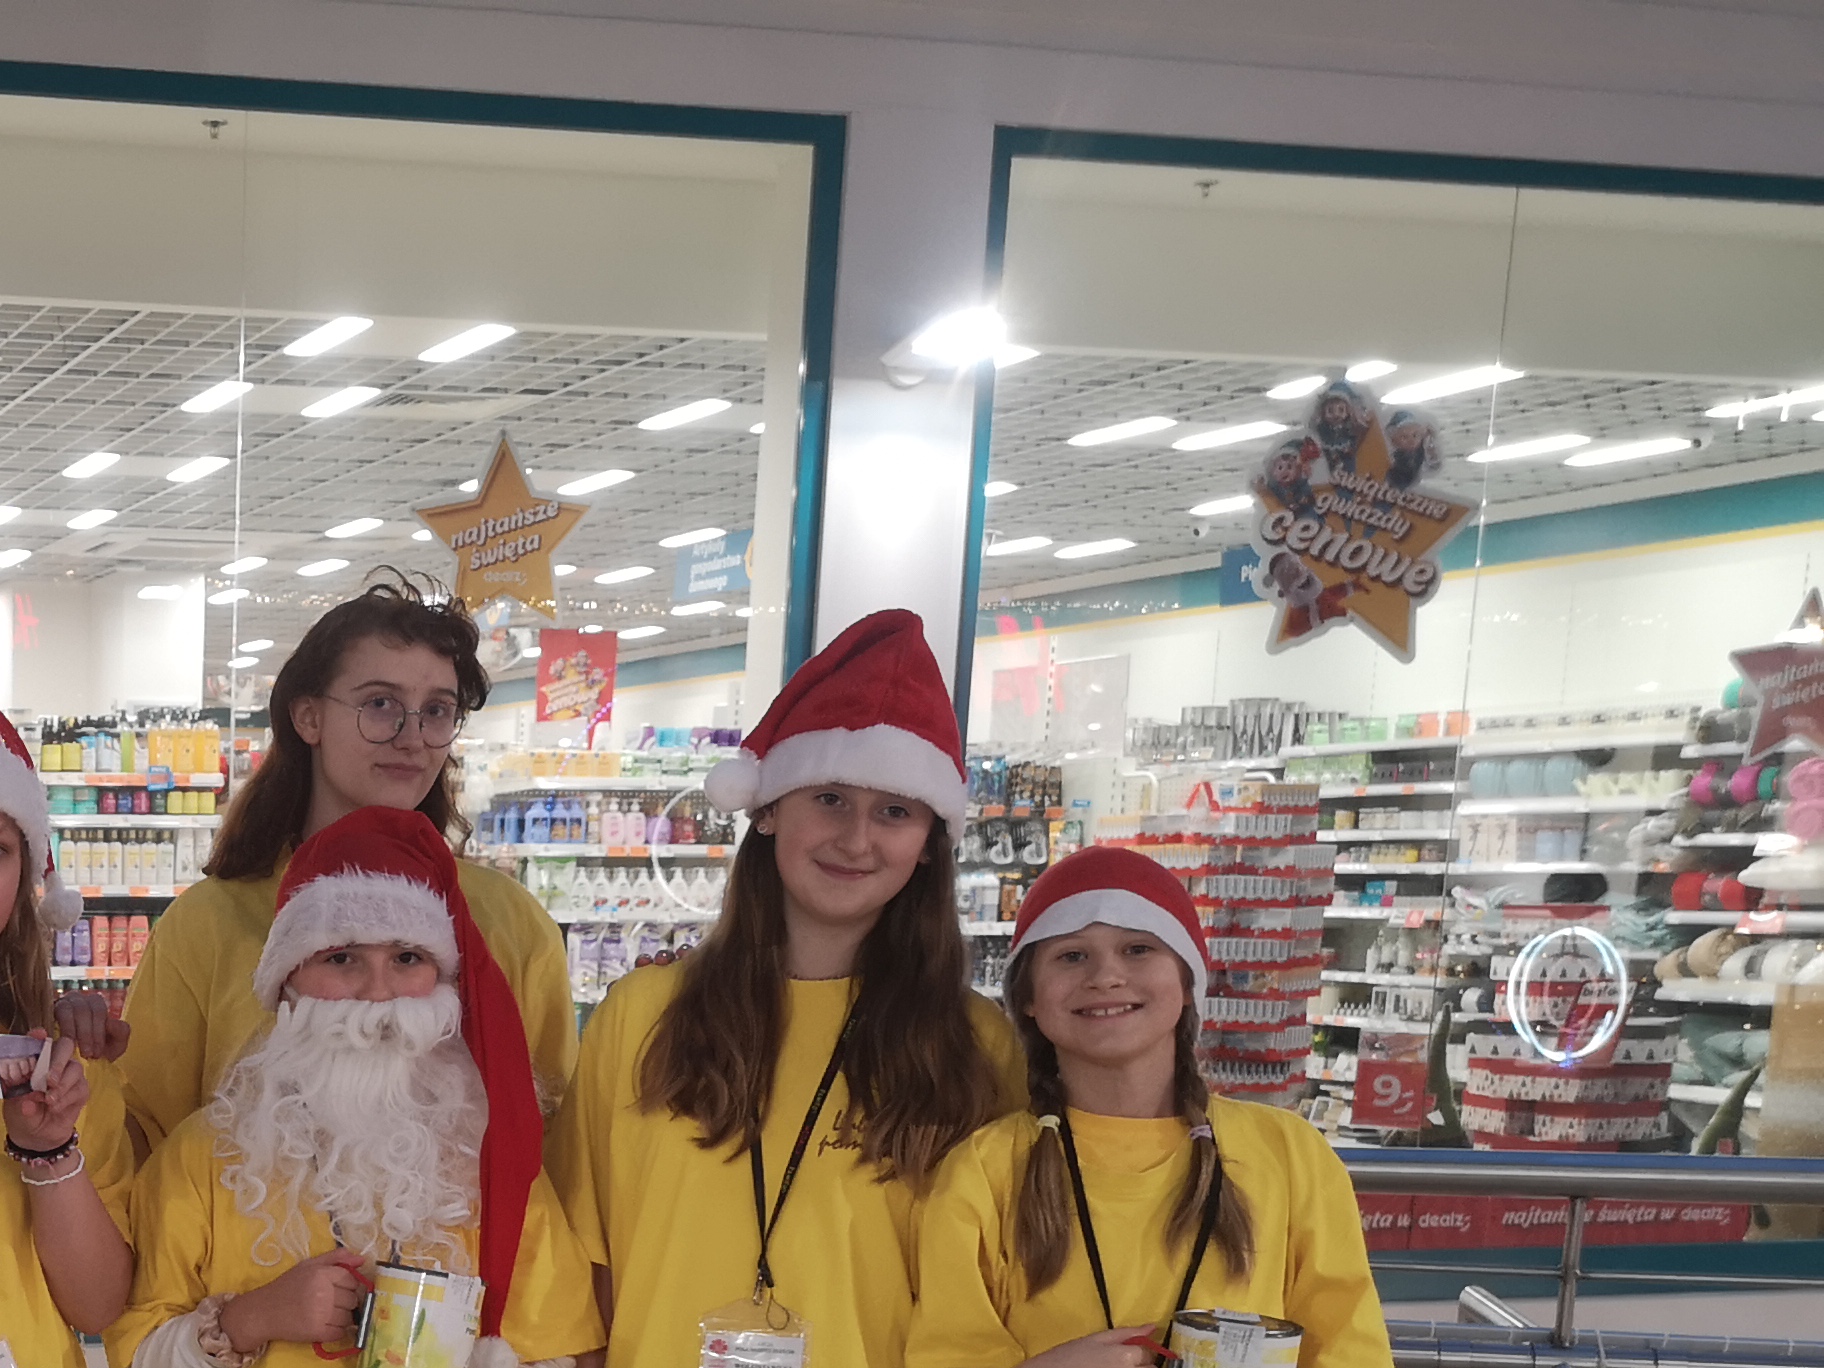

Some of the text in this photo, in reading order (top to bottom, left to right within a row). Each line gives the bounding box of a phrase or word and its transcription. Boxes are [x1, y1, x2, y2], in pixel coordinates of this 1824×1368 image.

[1329, 461, 1449, 520] świąteczne
[451, 500, 560, 549] najtańsze
[1315, 494, 1411, 540] gwiazdy
[470, 534, 541, 570] święta
[1261, 509, 1436, 595] cenowe
[1597, 1205, 1657, 1223] święta
[1659, 1205, 1676, 1219] w
